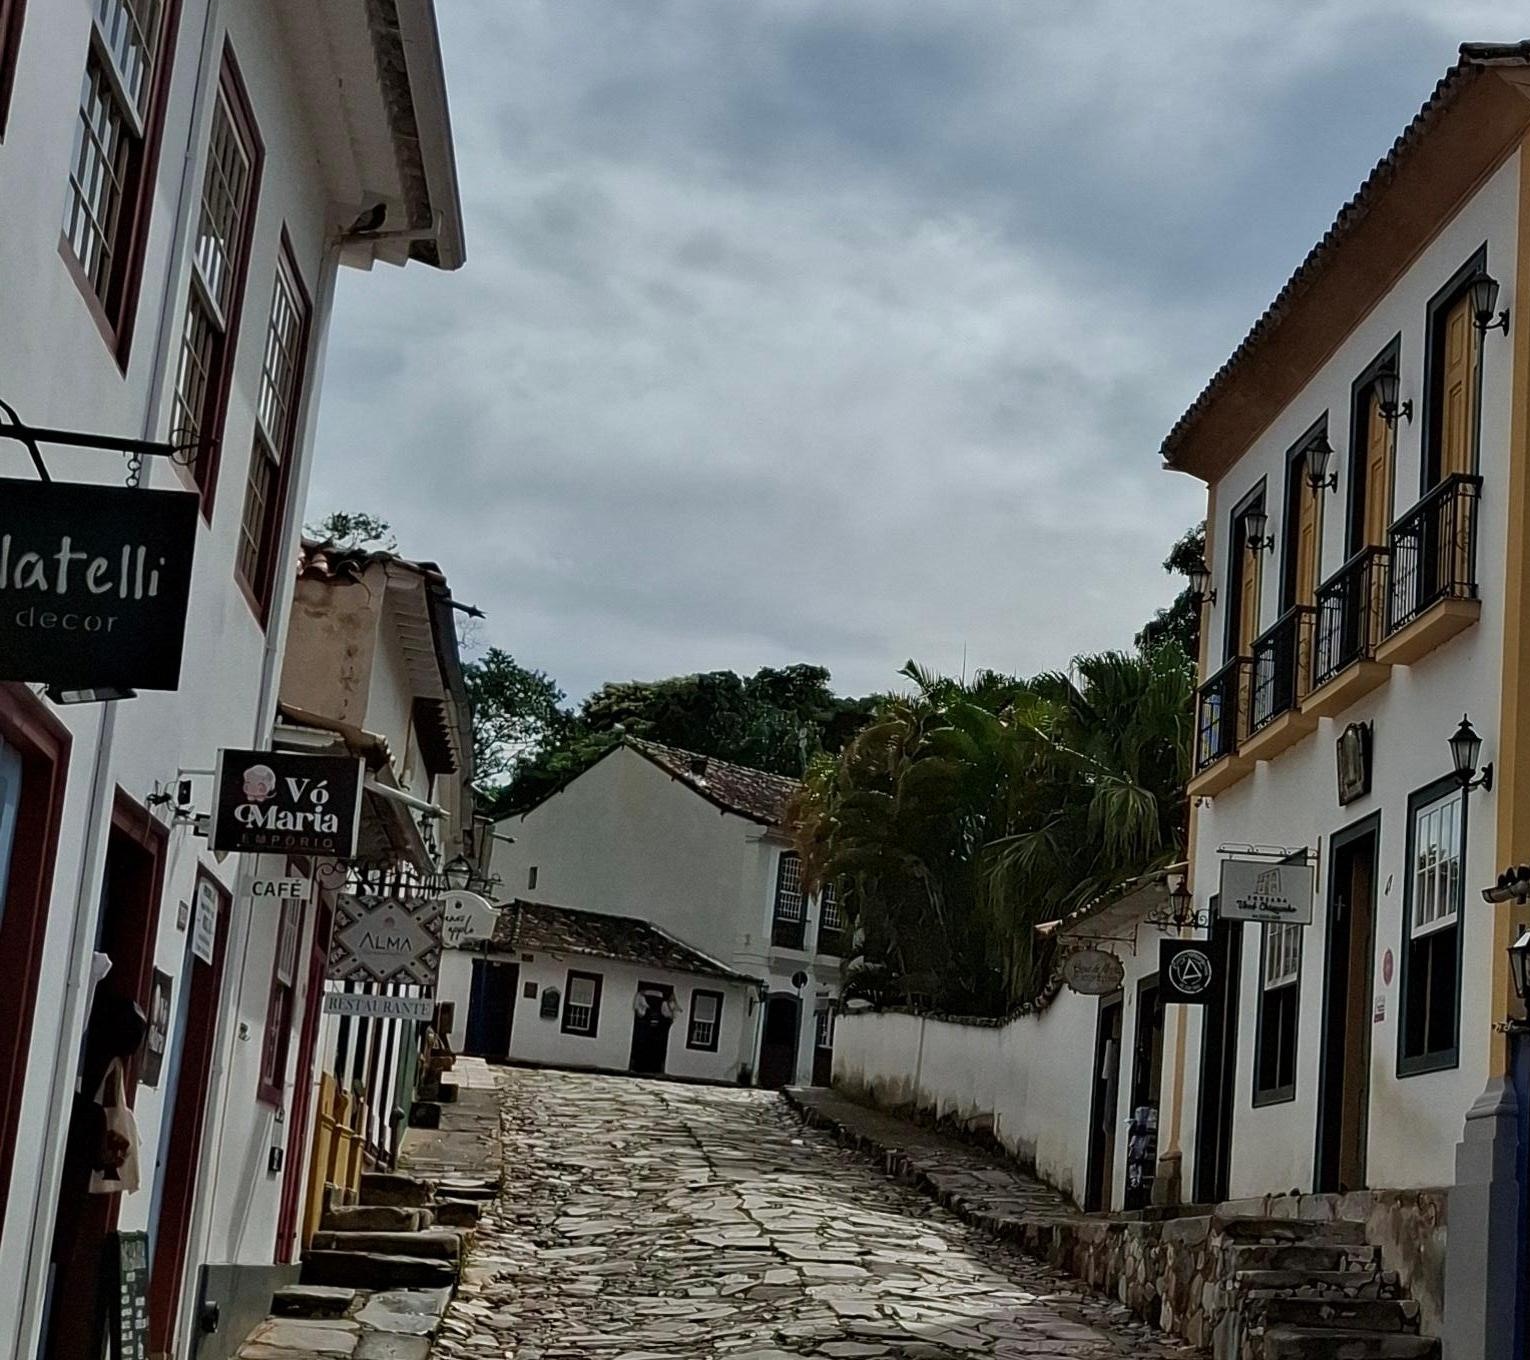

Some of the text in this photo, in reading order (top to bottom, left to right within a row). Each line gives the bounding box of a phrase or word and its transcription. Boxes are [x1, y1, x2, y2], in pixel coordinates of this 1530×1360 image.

[16, 607, 118, 632] decor
[284, 777, 329, 805] Vó
[234, 803, 339, 834] Maria
[252, 879, 302, 898] CAFÉ
[359, 931, 412, 952] ALMA
[328, 997, 430, 1016] RESTAURANTE
